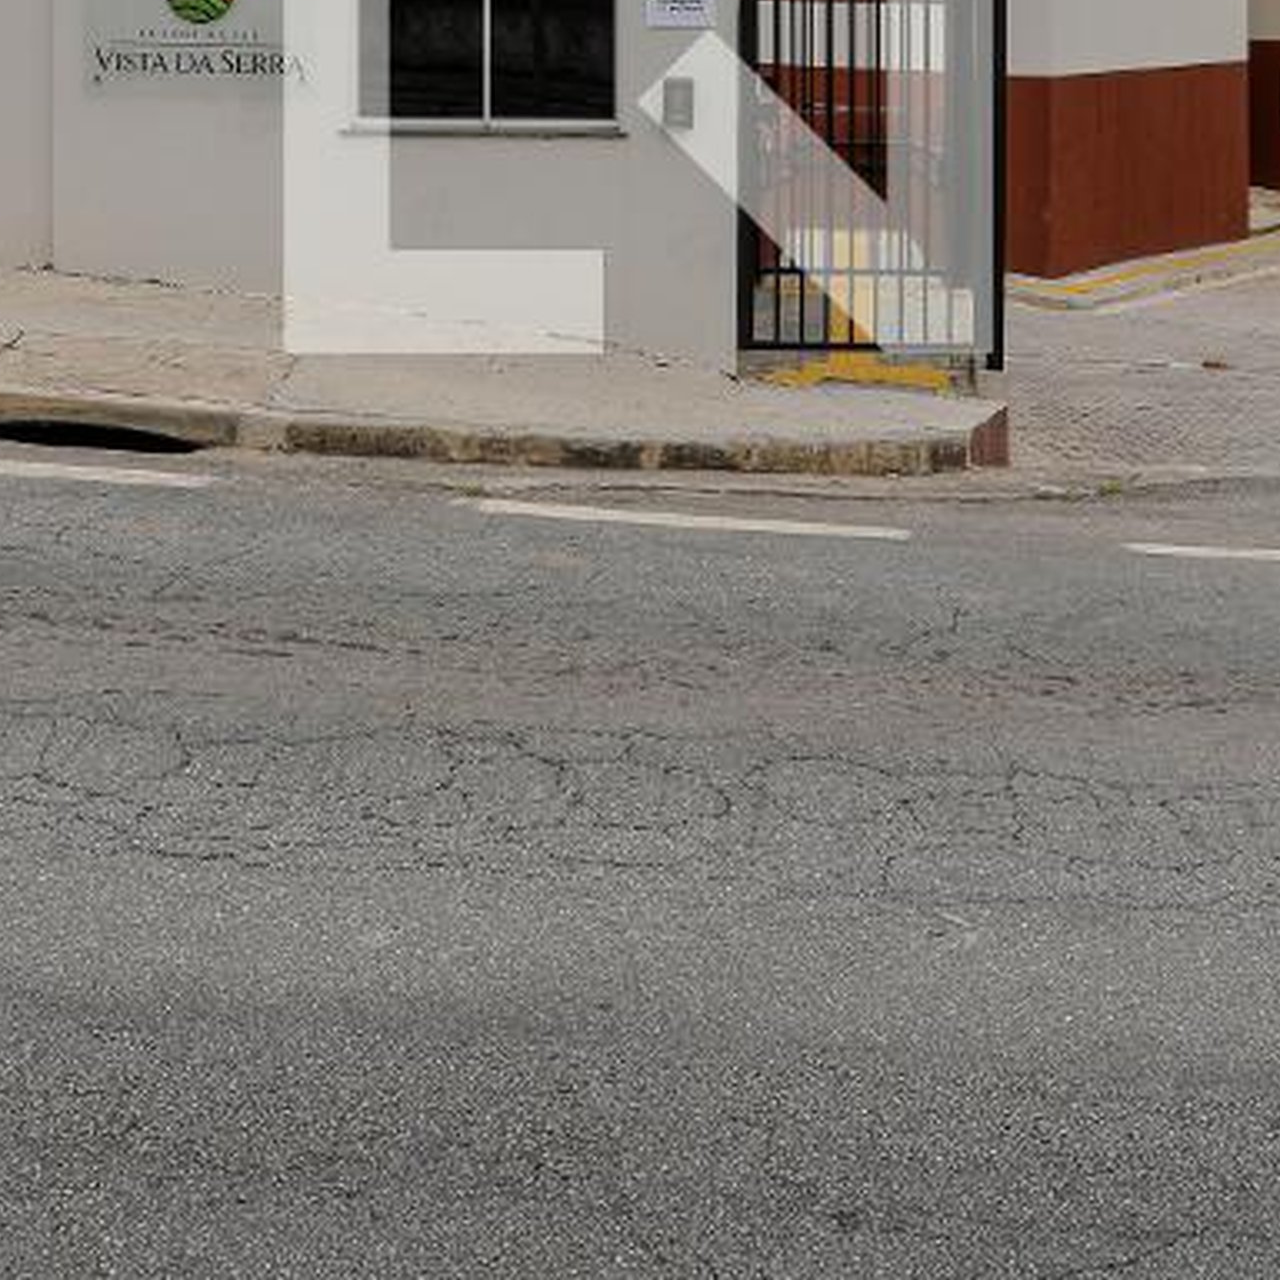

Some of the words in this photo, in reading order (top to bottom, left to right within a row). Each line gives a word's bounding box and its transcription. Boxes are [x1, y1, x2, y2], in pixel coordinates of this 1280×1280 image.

[94, 48, 169, 72] VISTA
[175, 51, 215, 74] DA
[220, 49, 307, 80] SERRA
